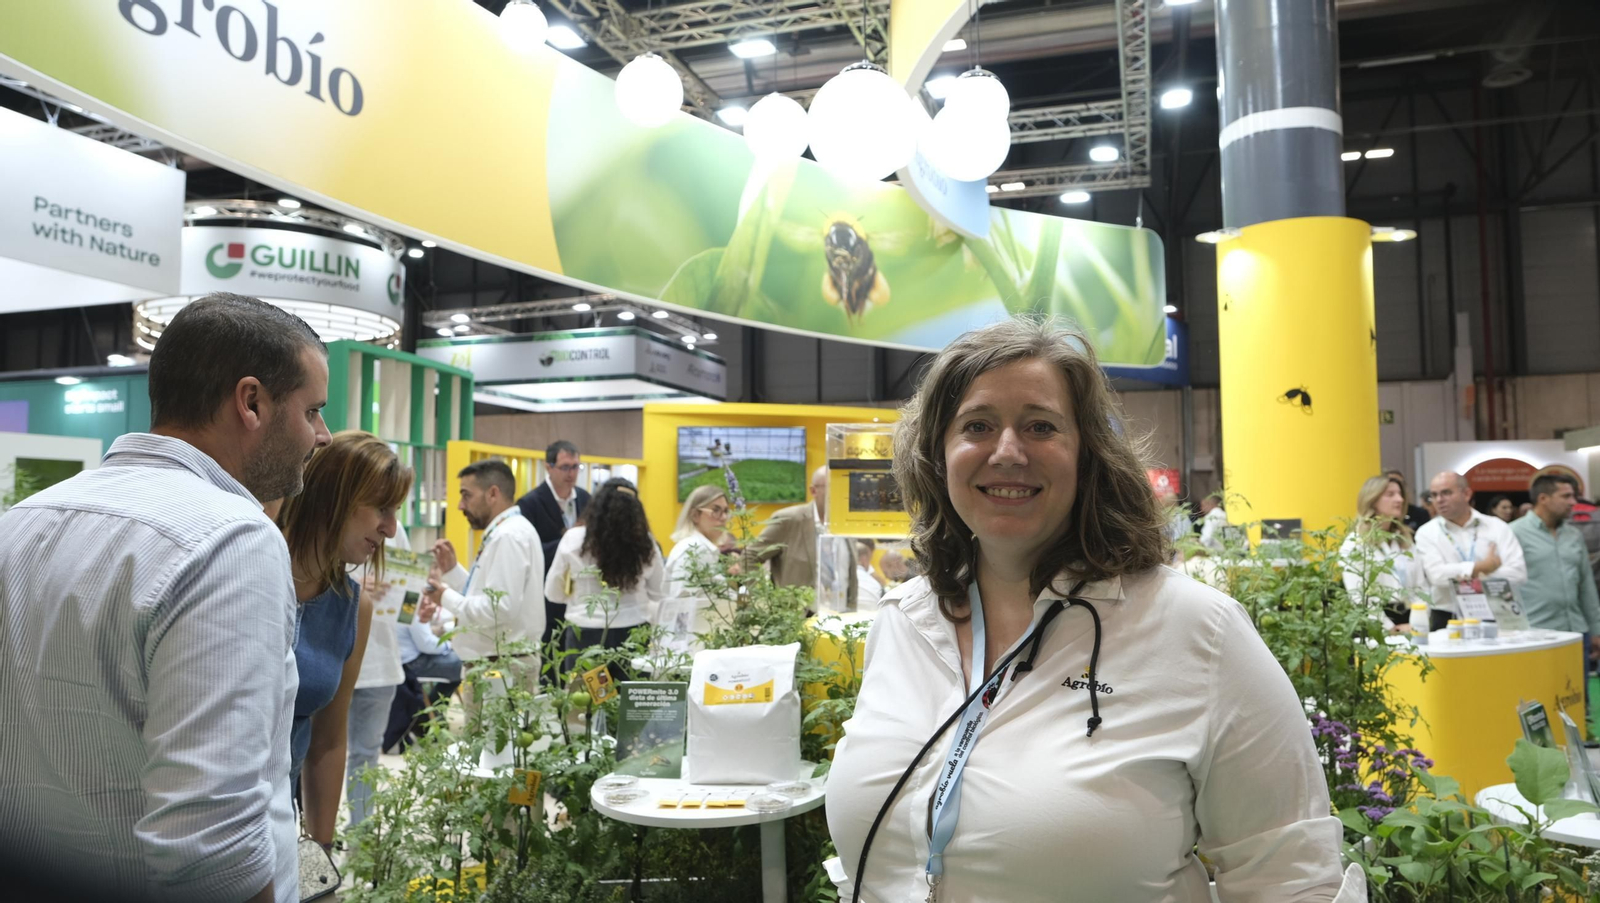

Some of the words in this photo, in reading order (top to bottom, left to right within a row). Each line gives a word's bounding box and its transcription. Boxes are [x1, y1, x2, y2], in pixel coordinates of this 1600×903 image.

[33, 196, 133, 238] Partners
[32, 221, 83, 248] with
[90, 234, 161, 267] Nature
[251, 244, 360, 279] GUILLIN
[250, 270, 360, 292] #weprotectyourfood
[962, 733, 973, 751] control
